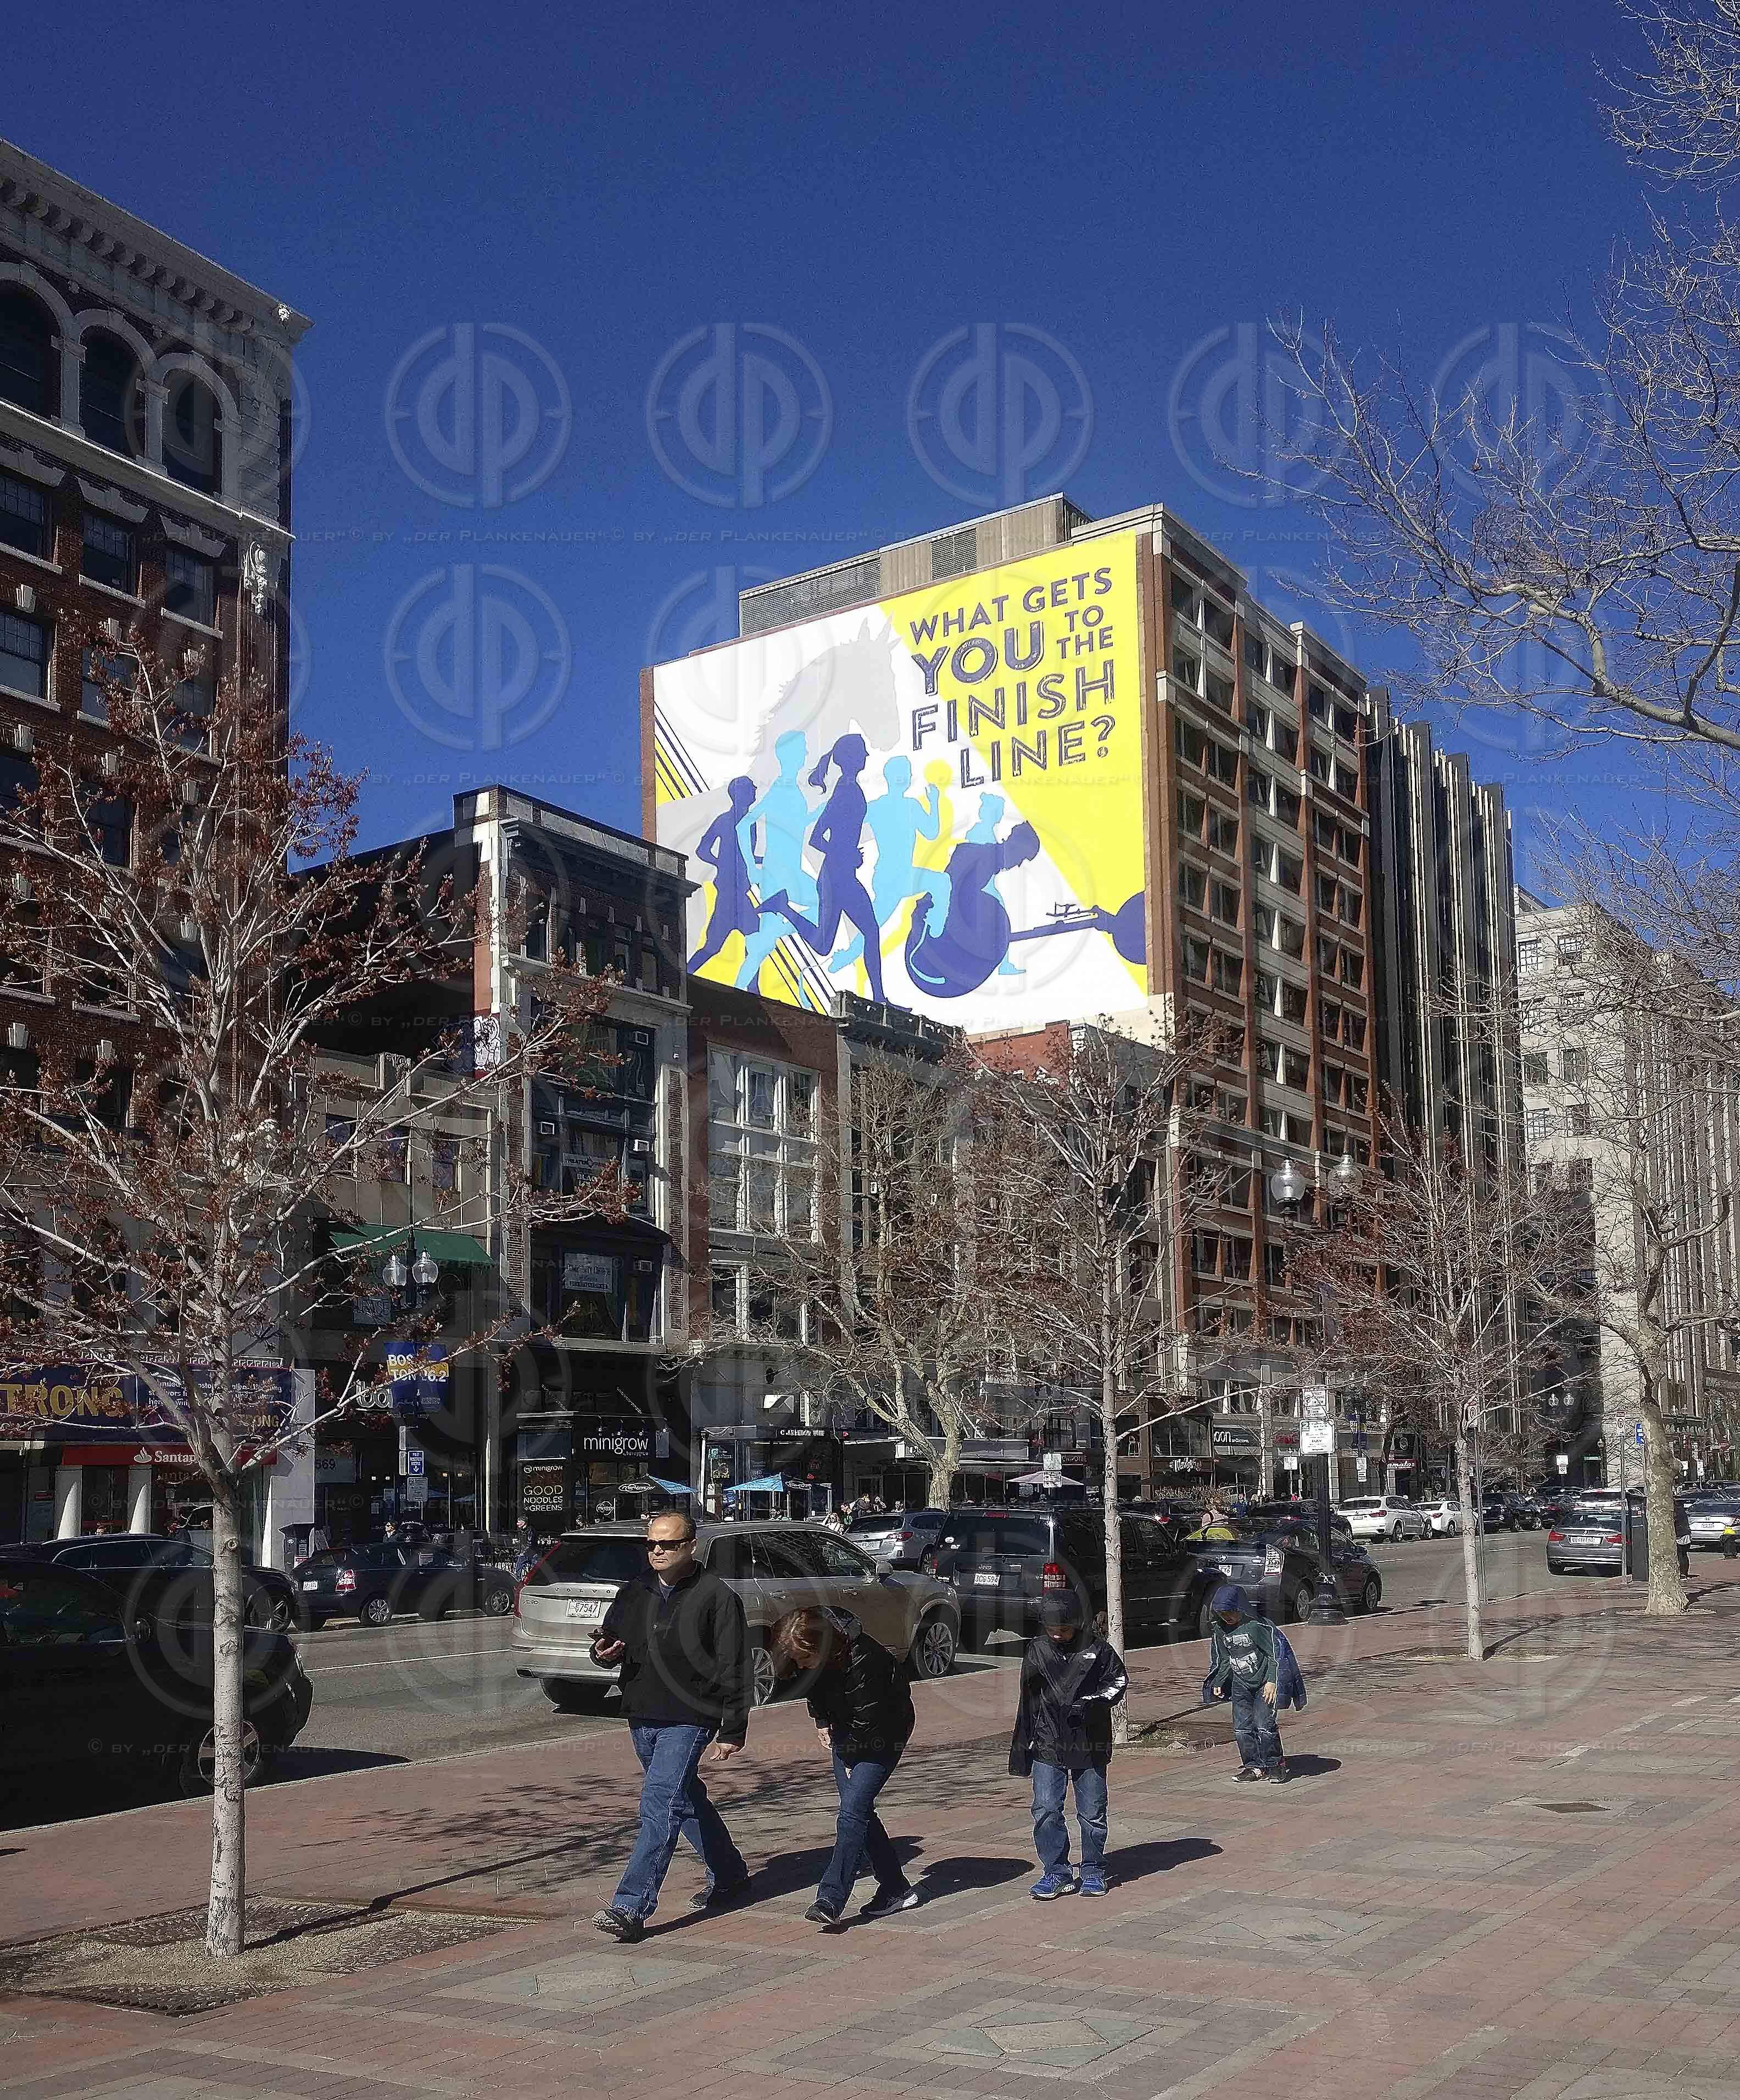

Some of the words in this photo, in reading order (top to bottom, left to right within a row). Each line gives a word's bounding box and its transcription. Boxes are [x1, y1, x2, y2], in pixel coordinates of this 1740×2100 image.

[910, 595, 1008, 645] WHAT
[1023, 567, 1112, 612] GETS
[1065, 605, 1104, 633] TO
[1057, 625, 1113, 659] THE
[911, 621, 1044, 696] YOU
[912, 659, 1115, 751] FINISH
[961, 715, 1116, 789] LINE?
[584, 1436, 649, 1455] minigrow
[523, 1485, 563, 1495] GOOD
[523, 1496, 563, 1504] NOODLES
[580, 1603, 598, 1613] 7547
